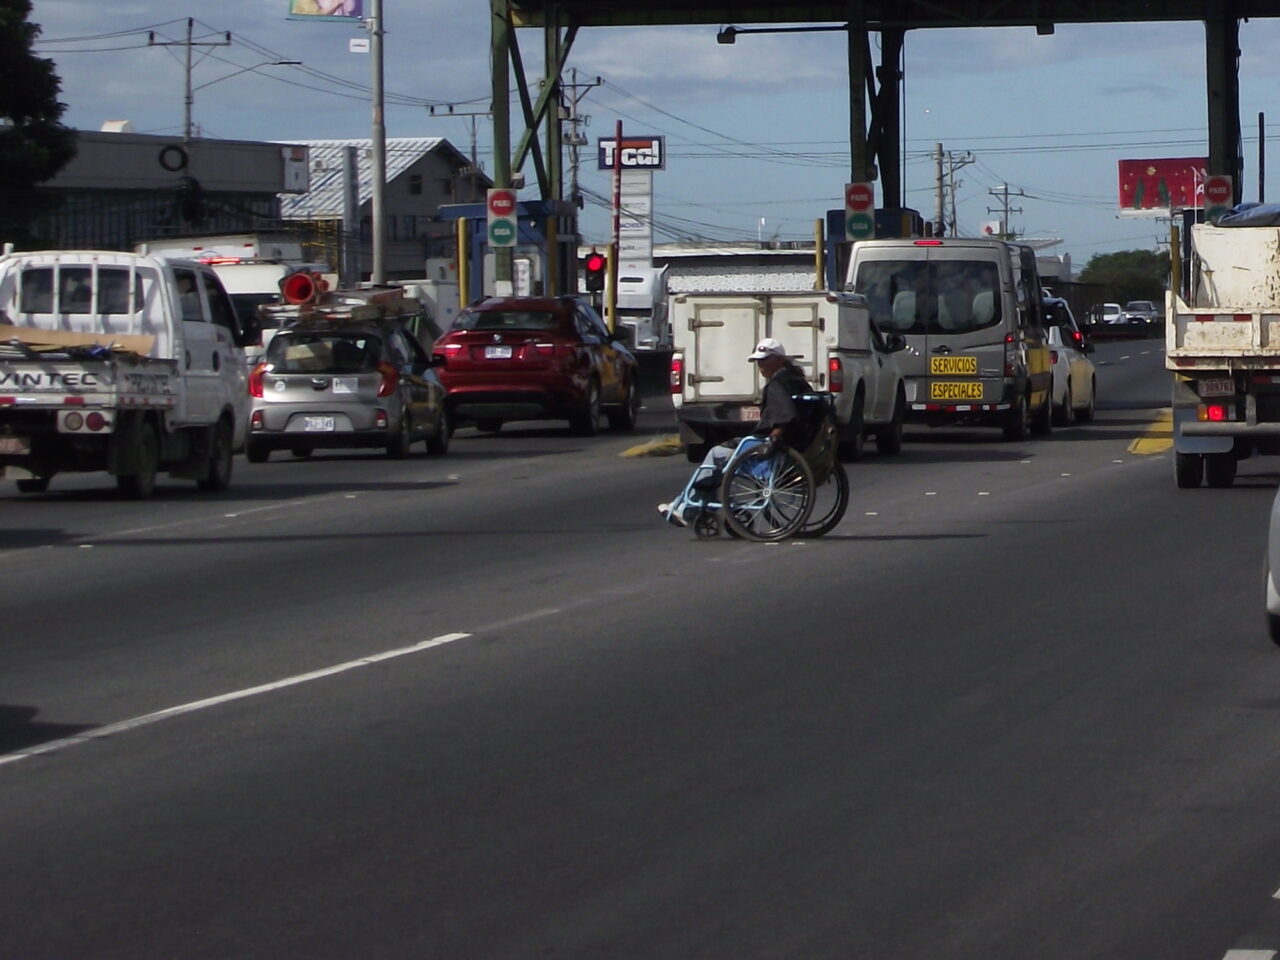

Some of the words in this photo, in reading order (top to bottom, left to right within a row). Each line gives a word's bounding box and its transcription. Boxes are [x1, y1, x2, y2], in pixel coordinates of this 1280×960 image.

[600, 140, 660, 166] Tcal
[933, 358, 976, 373] SERVICIOS
[0, 373, 98, 386] INTEC
[933, 383, 982, 398] ESPECIALES
